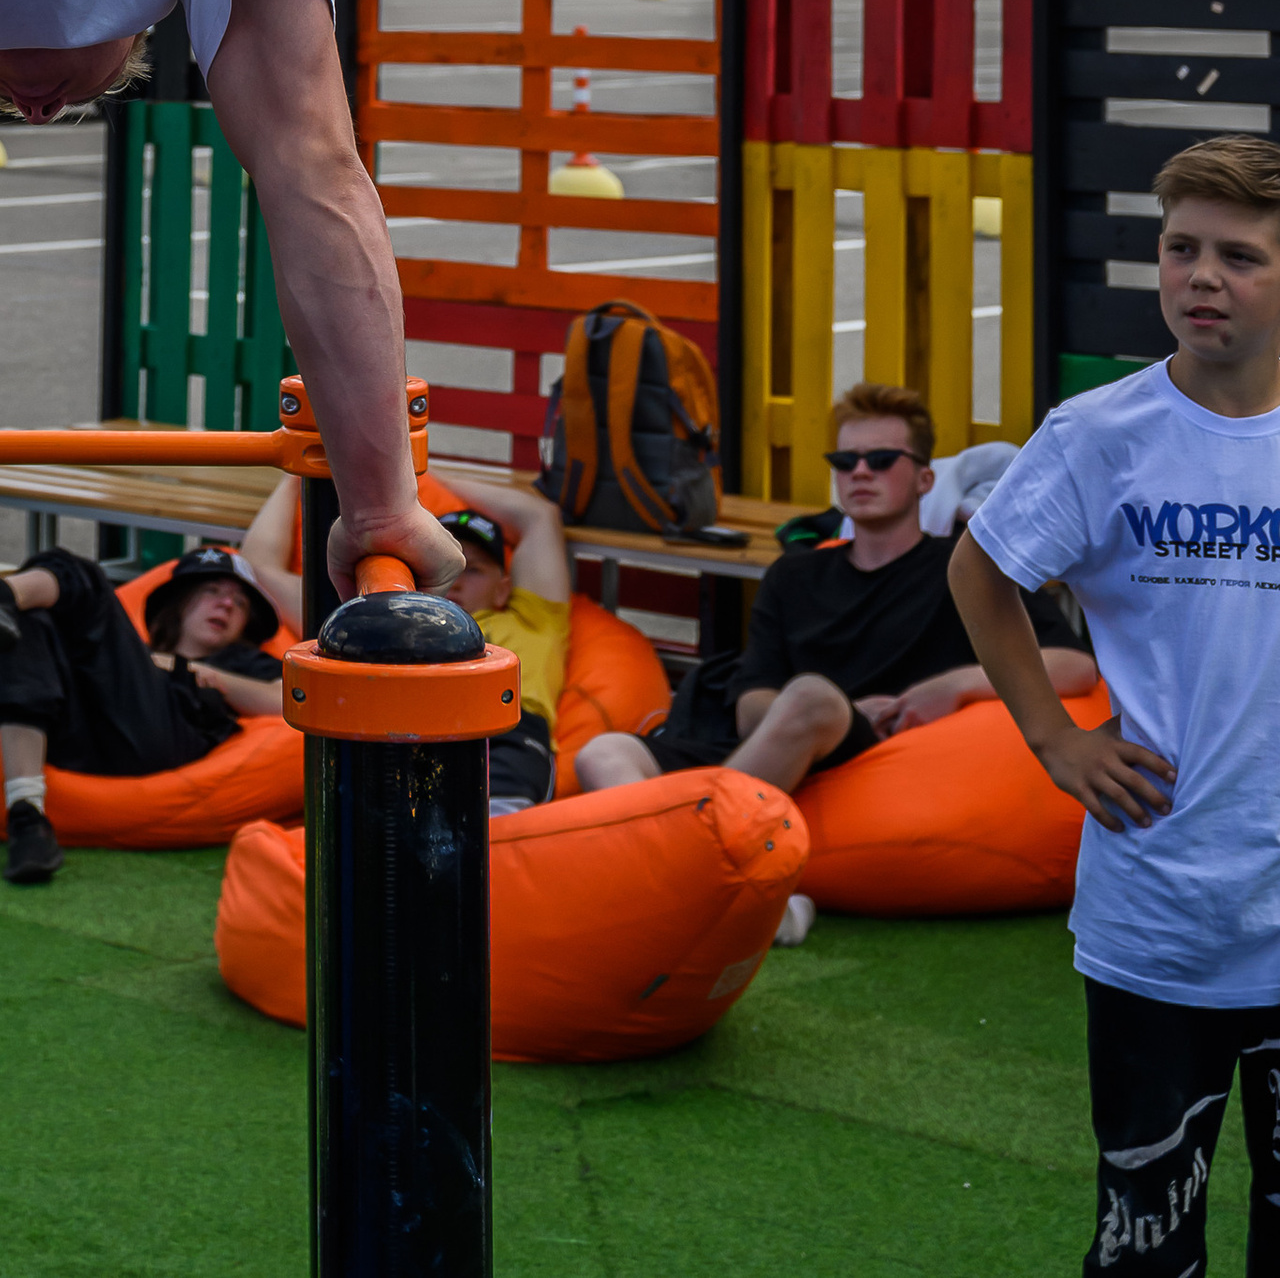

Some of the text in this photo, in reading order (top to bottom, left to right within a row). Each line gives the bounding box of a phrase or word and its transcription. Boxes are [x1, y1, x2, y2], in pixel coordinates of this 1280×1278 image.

[1154, 541, 1247, 560] STREET
[1138, 575, 1170, 585] ОСНОВЕ
[1174, 577, 1217, 586] КАЖДОГО
[1220, 579, 1251, 588] ГЕРОЯ
